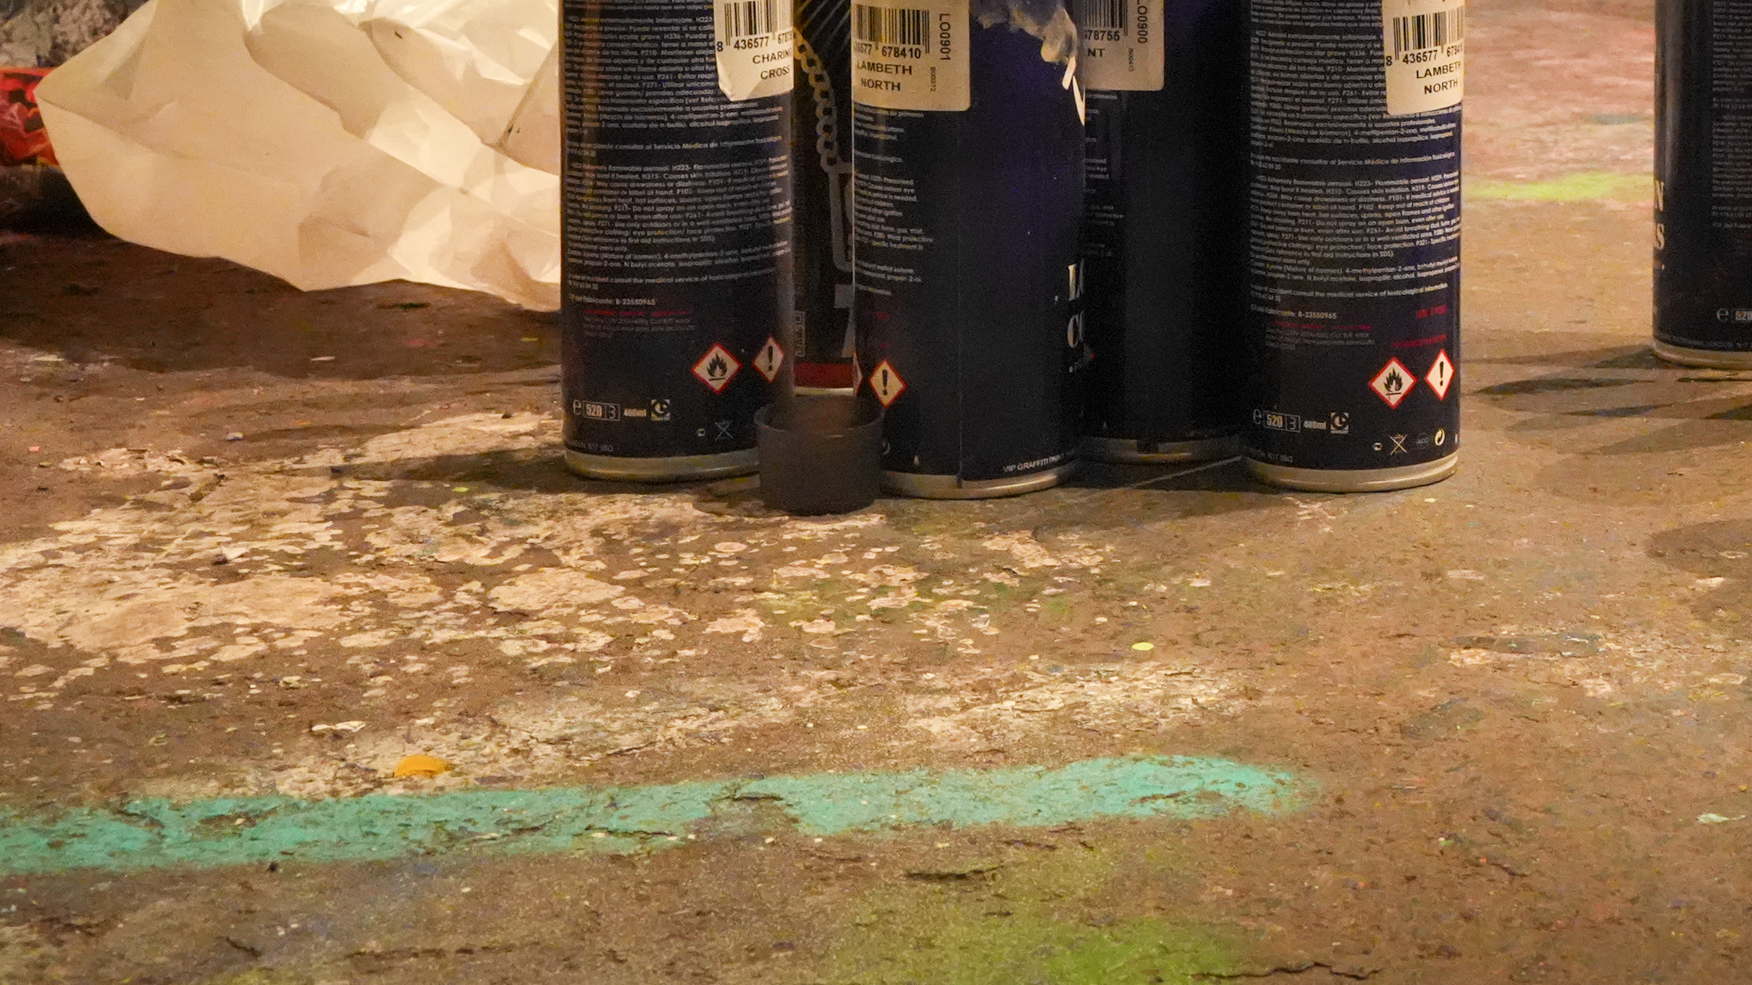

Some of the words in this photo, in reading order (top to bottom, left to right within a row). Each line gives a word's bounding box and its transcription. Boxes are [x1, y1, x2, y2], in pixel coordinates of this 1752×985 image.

[717, 41, 724, 52] 8
[733, 36, 769, 50] 436577
[939, 13, 951, 61] LO0901
[881, 46, 921, 59] 678410
[1386, 55, 1393, 66] 8
[1402, 49, 1438, 65] 436577
[760, 65, 791, 80] CROSS
[857, 60, 912, 75] LAMBETH
[861, 78, 901, 91] NORTH
[1424, 78, 1458, 95] NORTH
[586, 404, 603, 418] 520
[1266, 416, 1283, 428] 520
